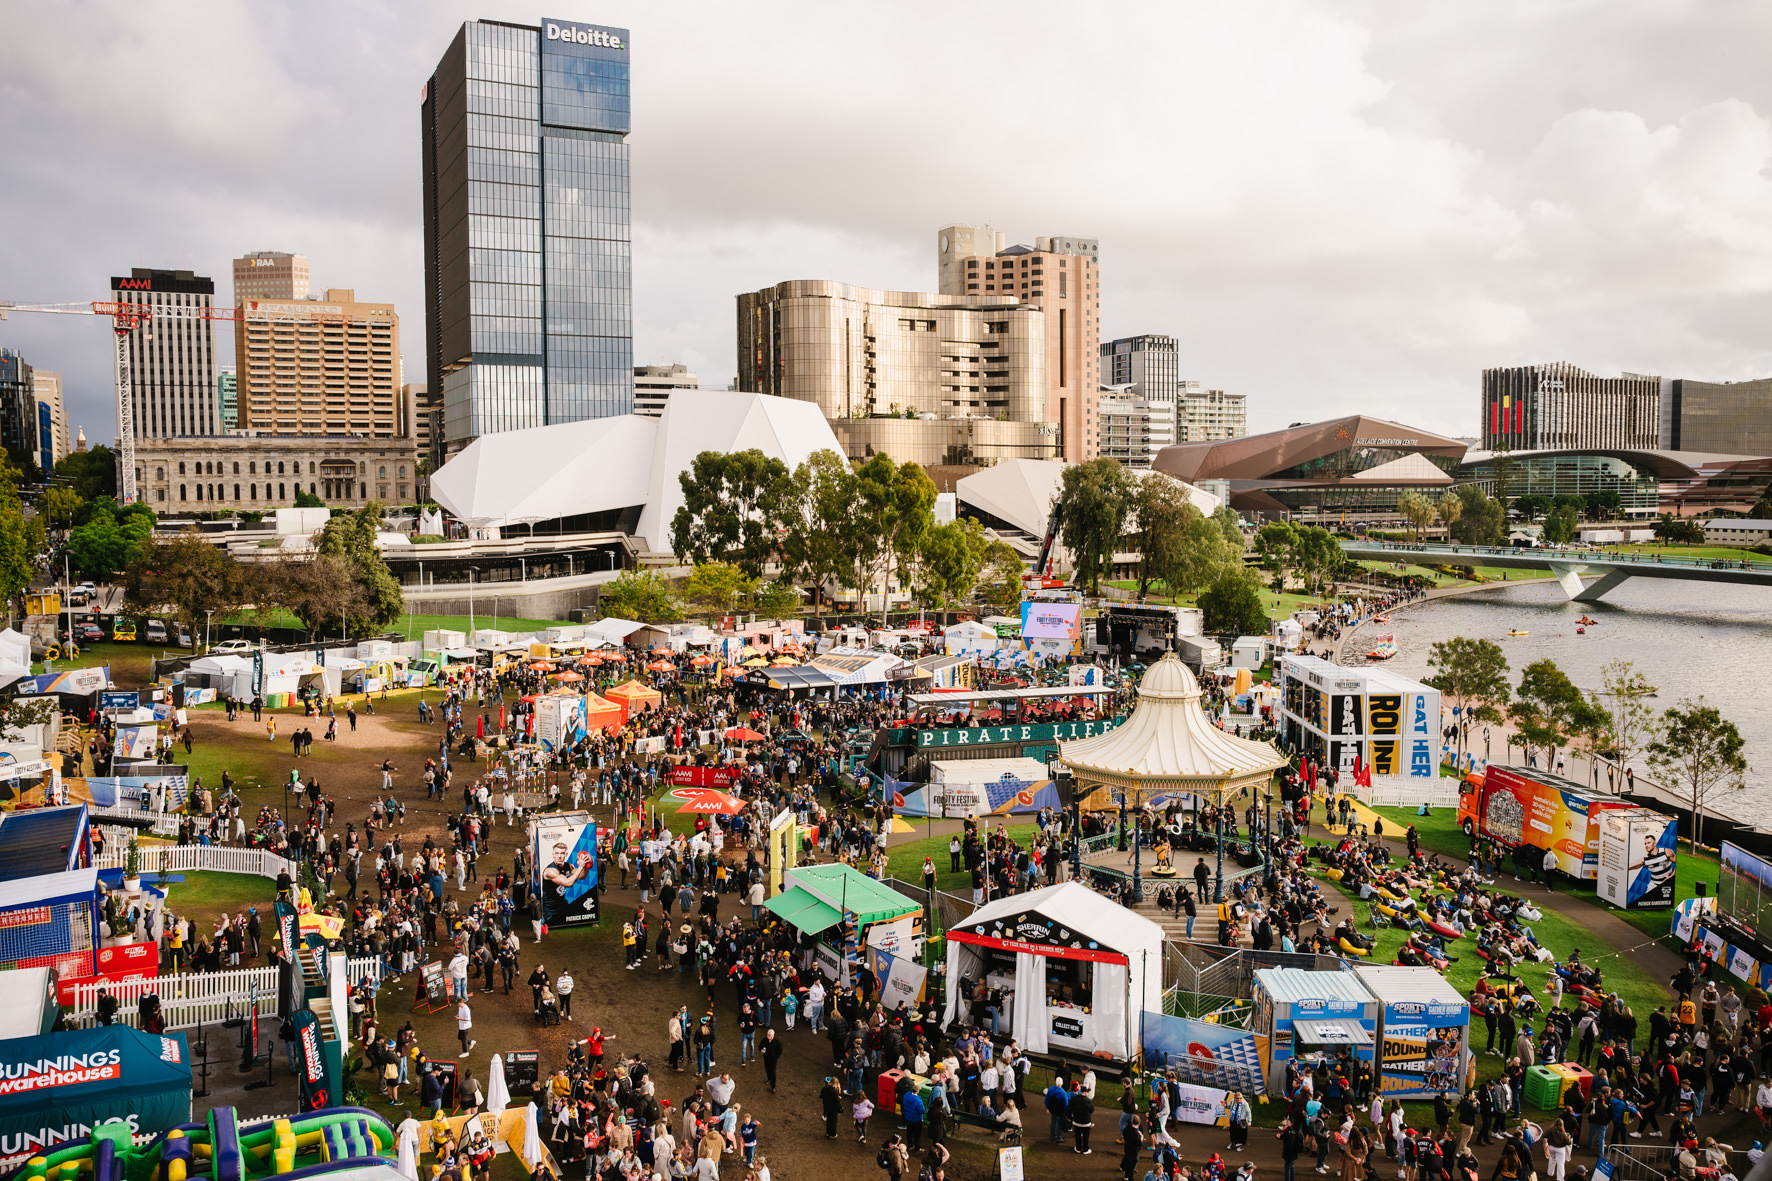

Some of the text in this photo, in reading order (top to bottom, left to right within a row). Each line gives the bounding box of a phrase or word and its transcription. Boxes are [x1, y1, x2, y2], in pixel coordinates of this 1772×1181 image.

[547, 22, 624, 49] Deloitte.
[256, 258, 274, 267] RAA
[119, 278, 150, 290] AAMI
[922, 721, 1112, 745] PIRATE LIFE
[1369, 696, 1401, 774] ROUND
[1411, 695, 1431, 776] GATHER
[956, 795, 980, 804] FESTIVAL
[1016, 923, 1050, 936] SHERRIN
[1393, 1003, 1426, 1011] SPORTS
[1682, 1006, 1693, 1014] 23
[1056, 1022, 1070, 1030] COLLECT
[1384, 1026, 1427, 1037] GATHER
[310, 1022, 323, 1080] BUNNINGS
[1383, 1041, 1426, 1057] ROUND
[302, 1031, 315, 1082] warehouse
[1382, 1061, 1425, 1071] GATHER
[0, 1066, 113, 1092] warehouse
[1381, 1076, 1424, 1092] ROUND
[1194, 1102, 1212, 1110] FESTIVAL
